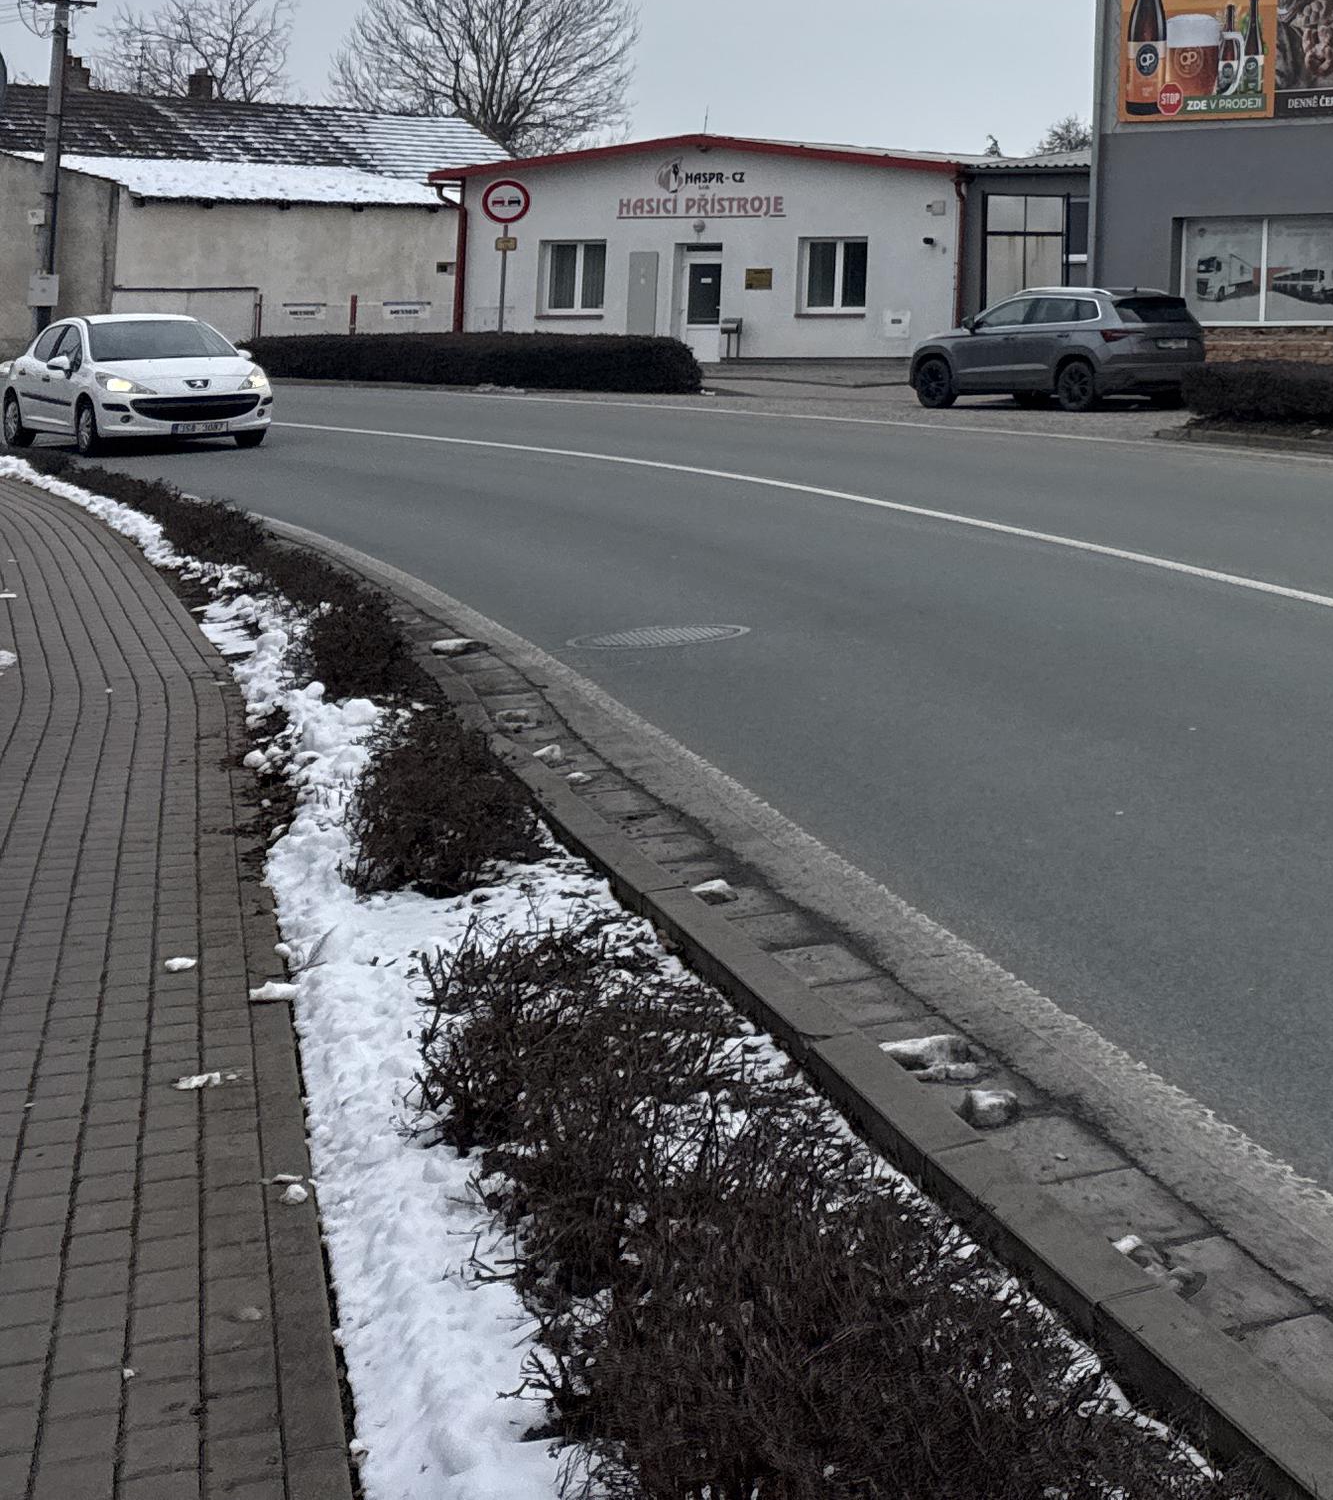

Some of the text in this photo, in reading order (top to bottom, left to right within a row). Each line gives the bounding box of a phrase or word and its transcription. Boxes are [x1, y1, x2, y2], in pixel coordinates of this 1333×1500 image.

[1160, 92, 1180, 106] STOP
[1186, 100, 1207, 111] ZDE
[1209, 99, 1217, 110] V
[1288, 96, 1318, 109] DENNĚ
[618, 193, 784, 216] HASICÍ PŘÍSTROJE
